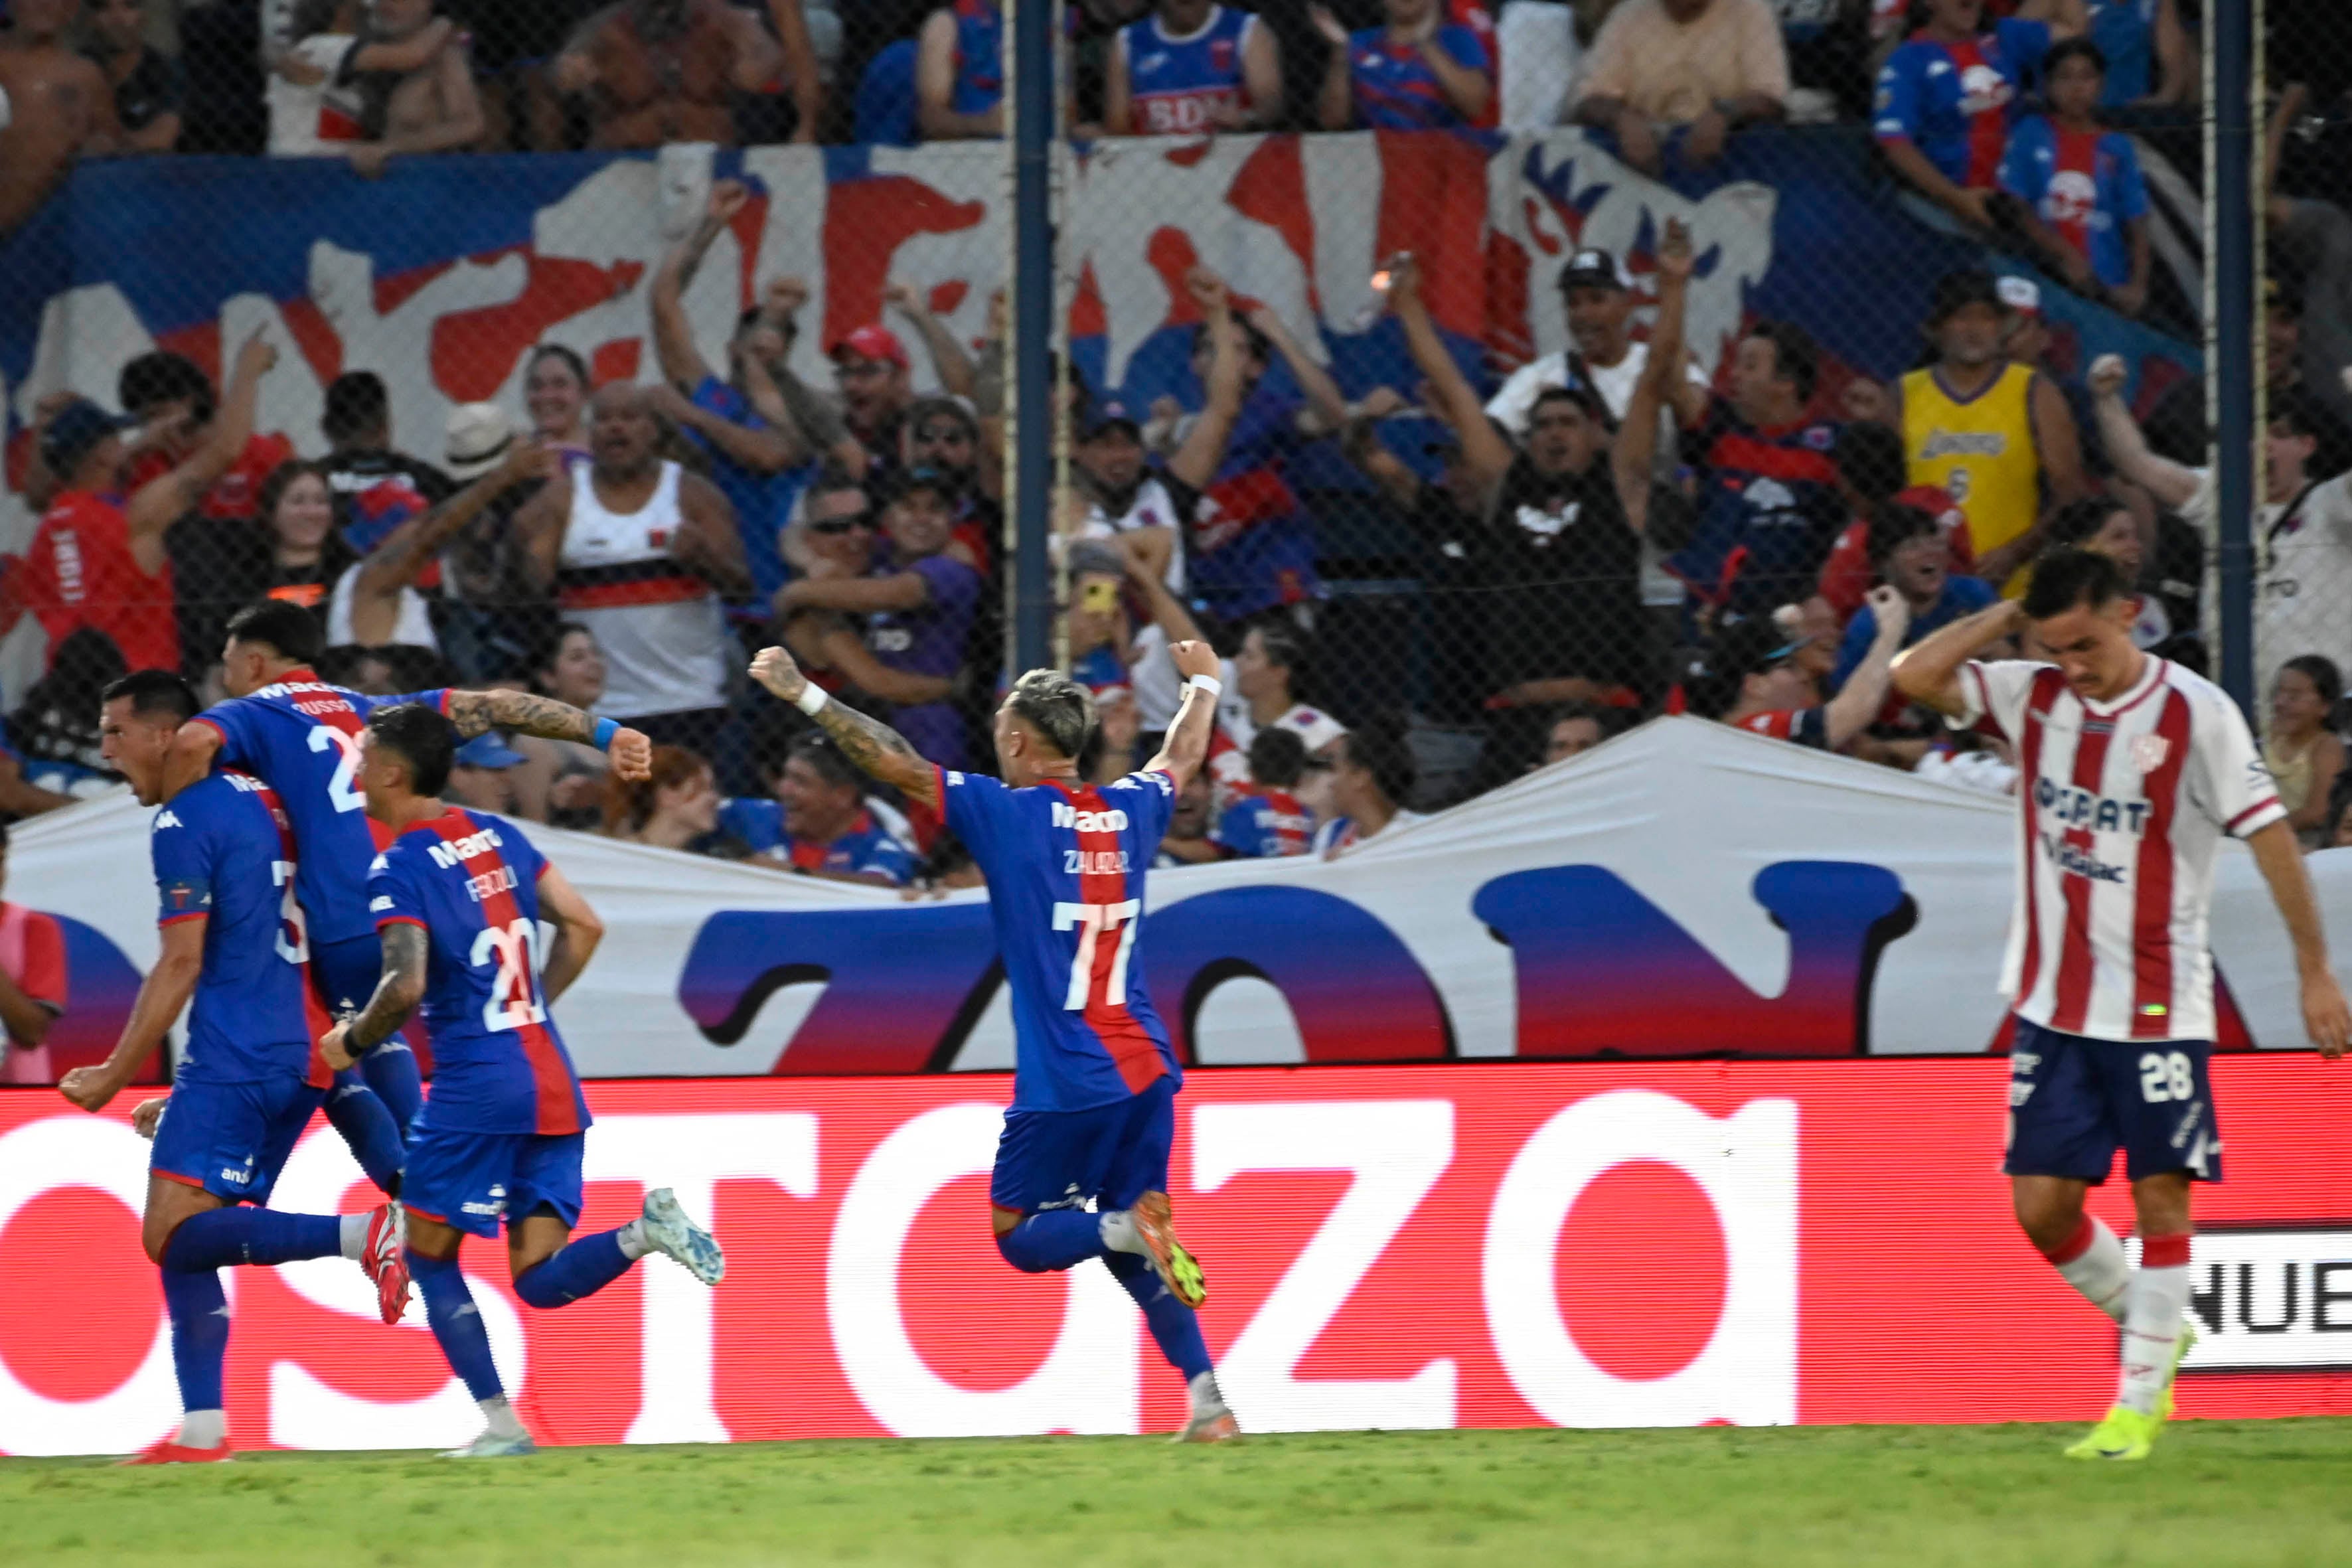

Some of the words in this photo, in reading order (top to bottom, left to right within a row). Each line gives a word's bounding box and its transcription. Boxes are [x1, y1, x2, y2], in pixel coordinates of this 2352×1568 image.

[470, 917, 548, 1033] 20
[1052, 898, 1142, 1011] 77
[2138, 1051, 2194, 1103] 28
